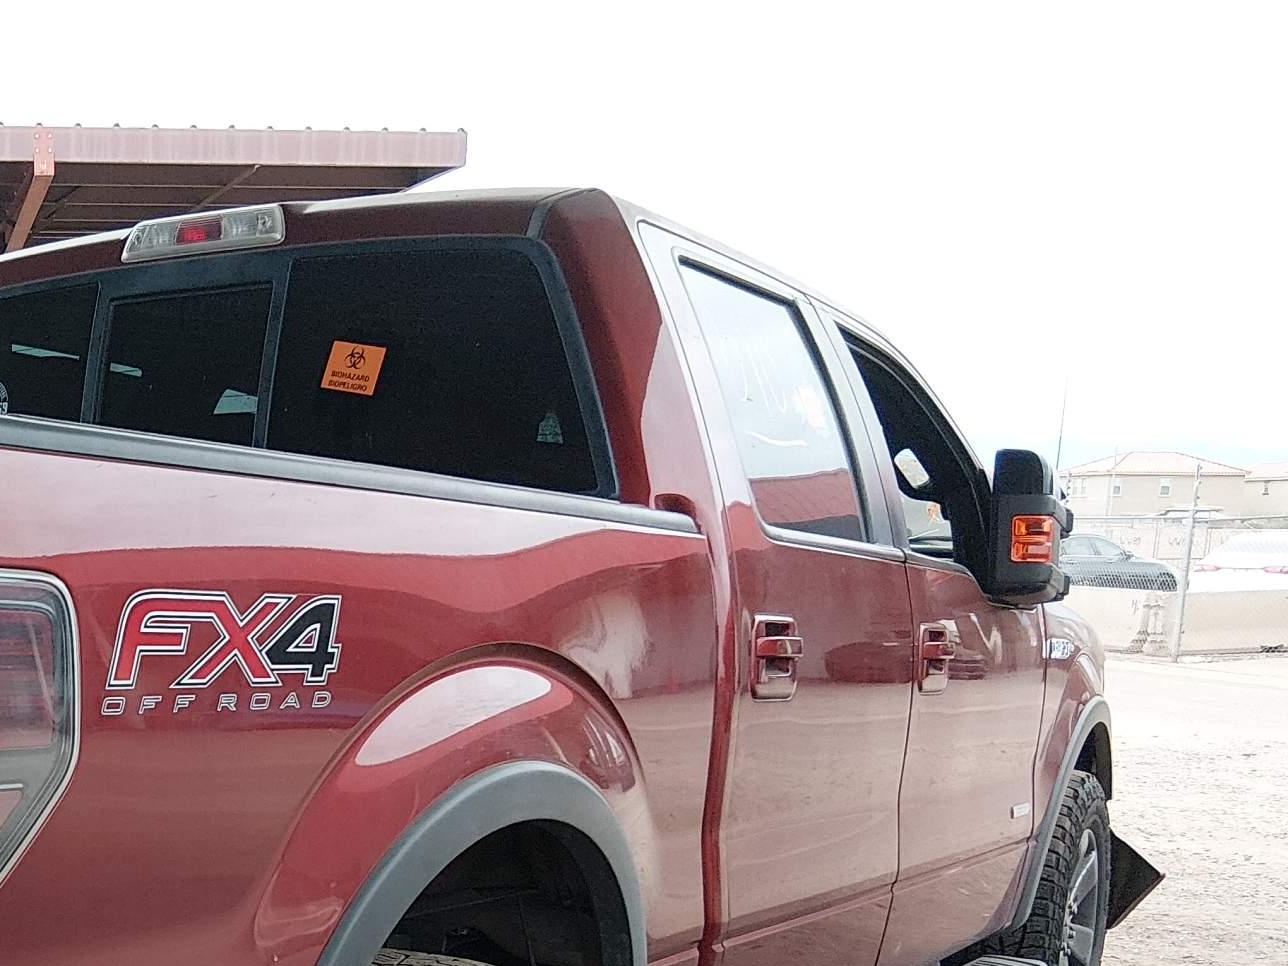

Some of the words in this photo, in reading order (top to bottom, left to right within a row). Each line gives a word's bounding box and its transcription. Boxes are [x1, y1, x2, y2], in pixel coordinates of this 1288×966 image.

[331, 370, 370, 382] BIOHAZARD
[328, 380, 367, 392] BIOPELIGRO
[105, 588, 342, 690] FX4
[100, 694, 195, 715] OFF
[216, 691, 332, 712] ROAD
